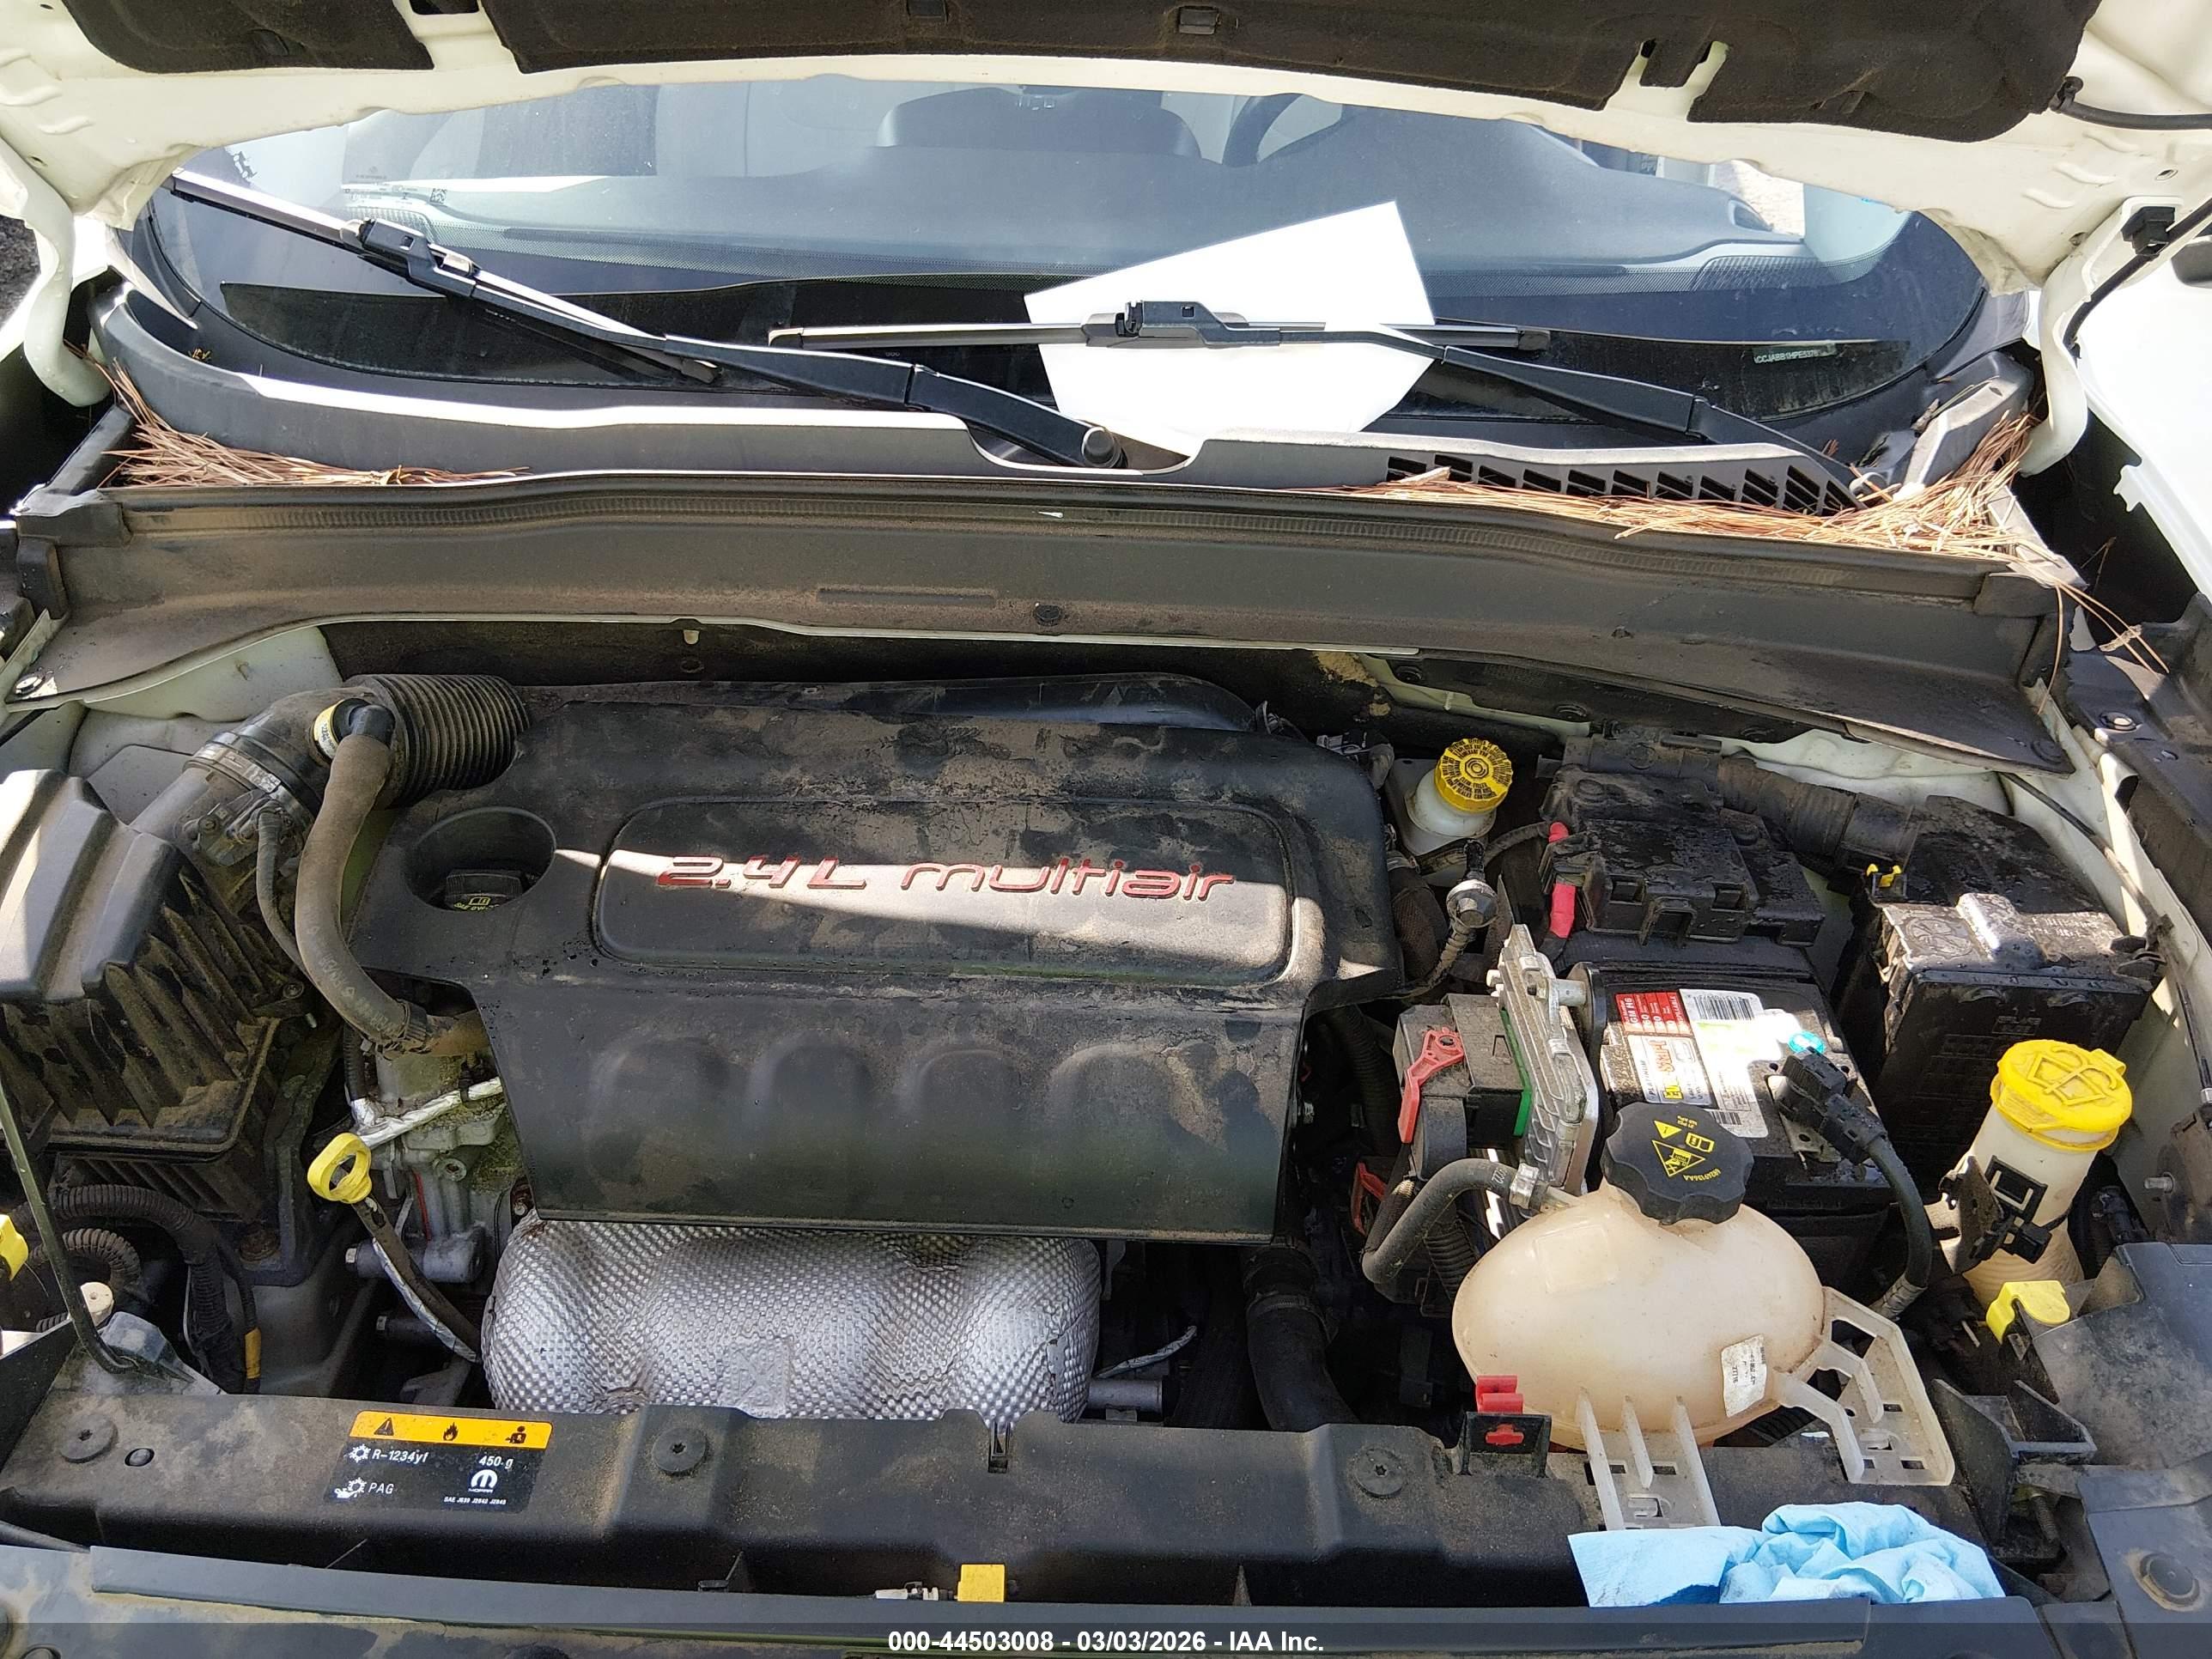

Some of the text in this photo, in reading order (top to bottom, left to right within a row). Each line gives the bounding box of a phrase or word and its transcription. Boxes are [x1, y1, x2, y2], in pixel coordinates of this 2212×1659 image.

[900, 858, 1236, 901] multiair
[371, 1449, 514, 1469] R-1234yf 450 g
[368, 1483, 395, 1495] PAG
